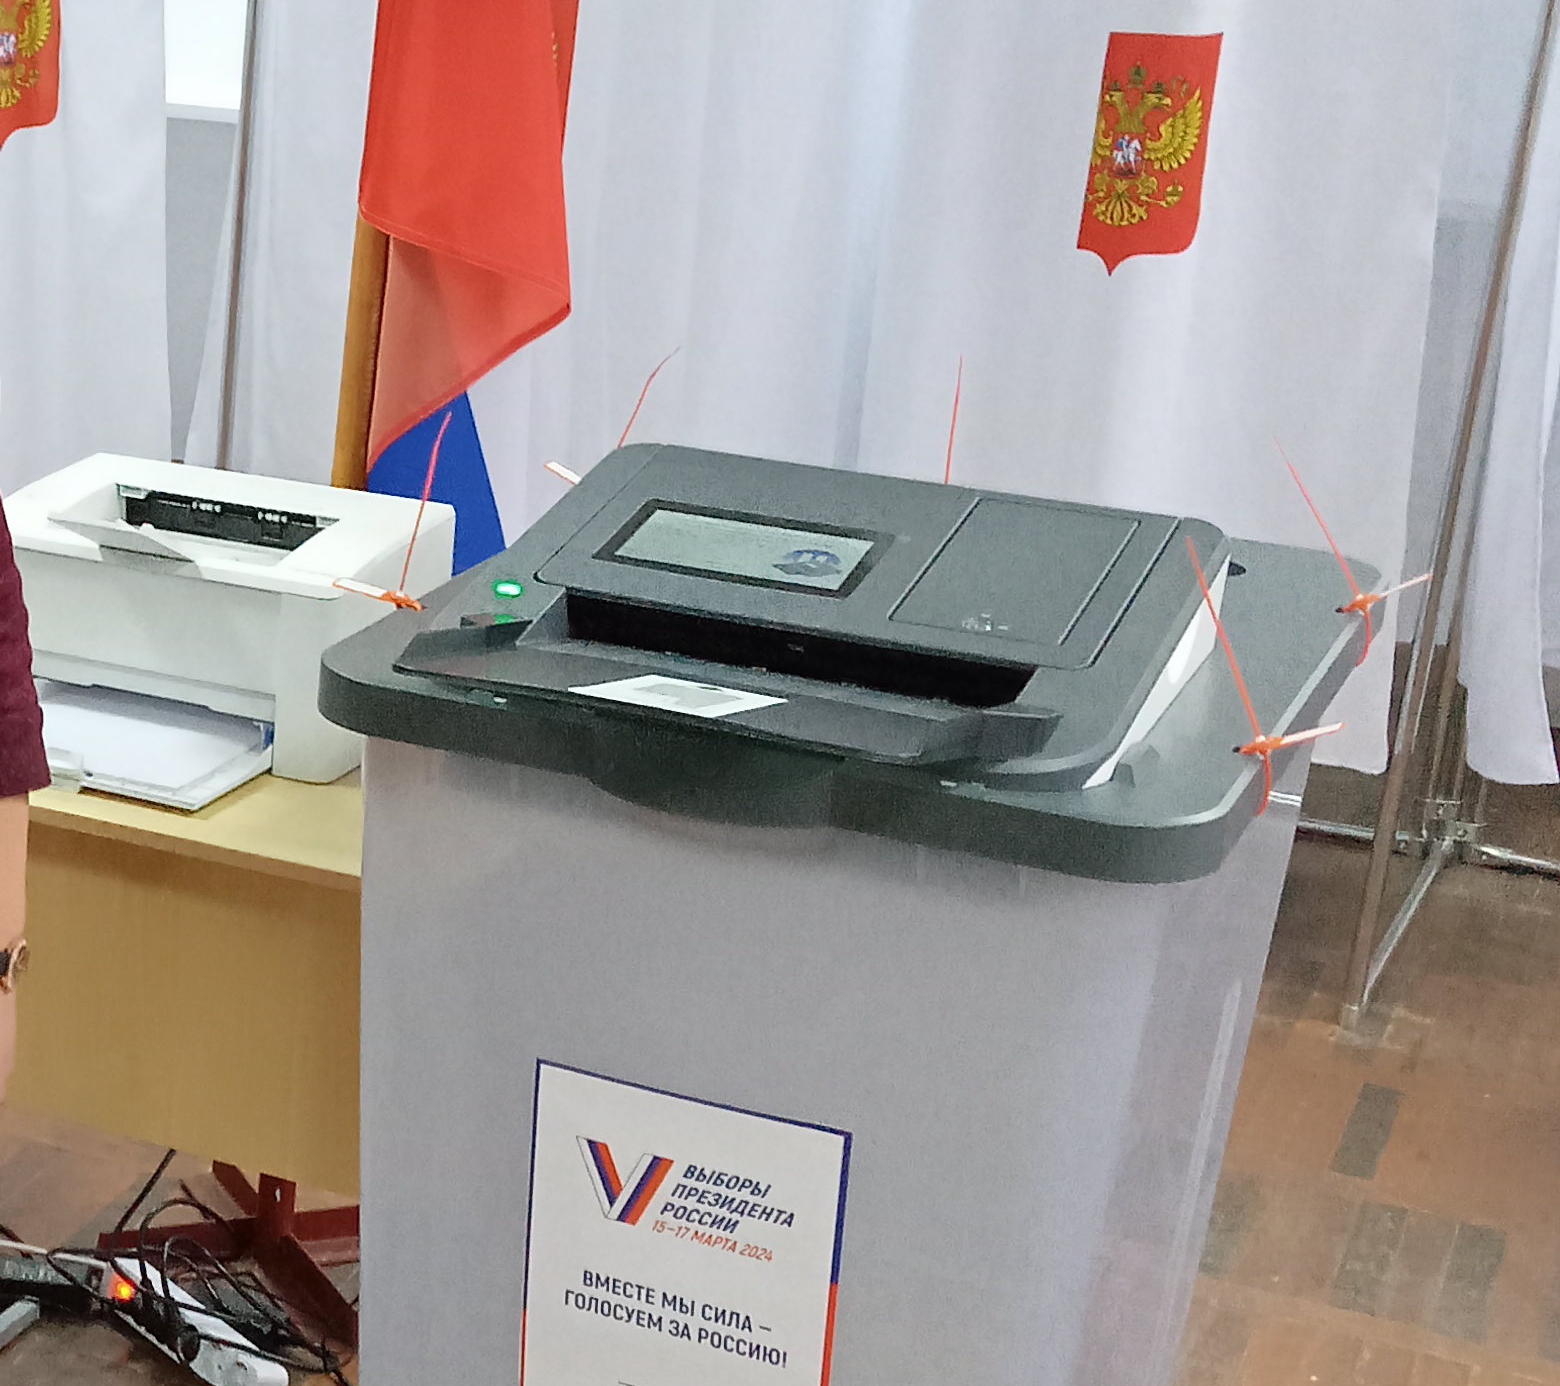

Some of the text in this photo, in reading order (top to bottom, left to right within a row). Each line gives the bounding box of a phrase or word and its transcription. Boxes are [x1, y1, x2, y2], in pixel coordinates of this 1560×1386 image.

[682, 1164, 772, 1199] ВЫБОРЫ
[660, 1201, 740, 1234] РОССИИ
[671, 1183, 795, 1228] ПРЕЗИДЕНТА
[690, 1230, 738, 1253] МАРТА
[739, 1243, 773, 1263] 2024
[583, 1269, 656, 1305] ВМЕСТЕ
[661, 1292, 696, 1317] МЫ
[701, 1303, 753, 1333] СИЛА
[564, 1288, 788, 1369] ГОЛОСУЕМ ЗА РОССИЮ!
